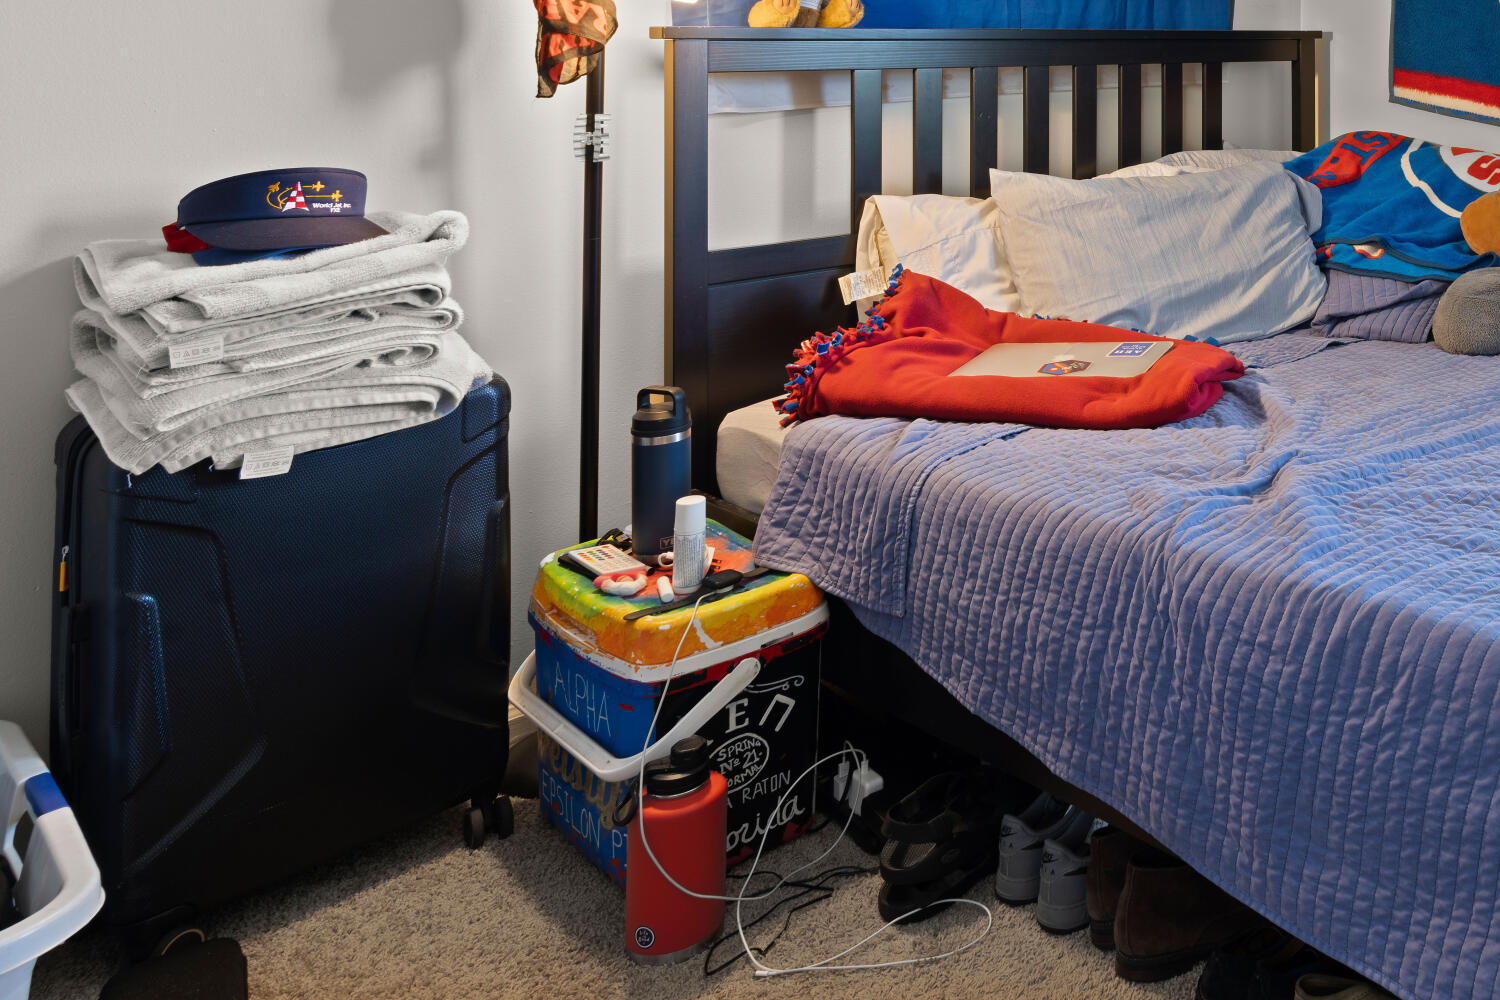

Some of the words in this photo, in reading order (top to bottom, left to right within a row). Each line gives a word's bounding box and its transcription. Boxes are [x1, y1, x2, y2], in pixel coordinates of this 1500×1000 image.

[553, 661, 612, 737] ALPHA
[716, 738, 761, 762] SPRING
[727, 763, 763, 788] ORMAL
[742, 770, 791, 805] RATON
[542, 768, 601, 849] EPSILON
[726, 795, 806, 852] orida
